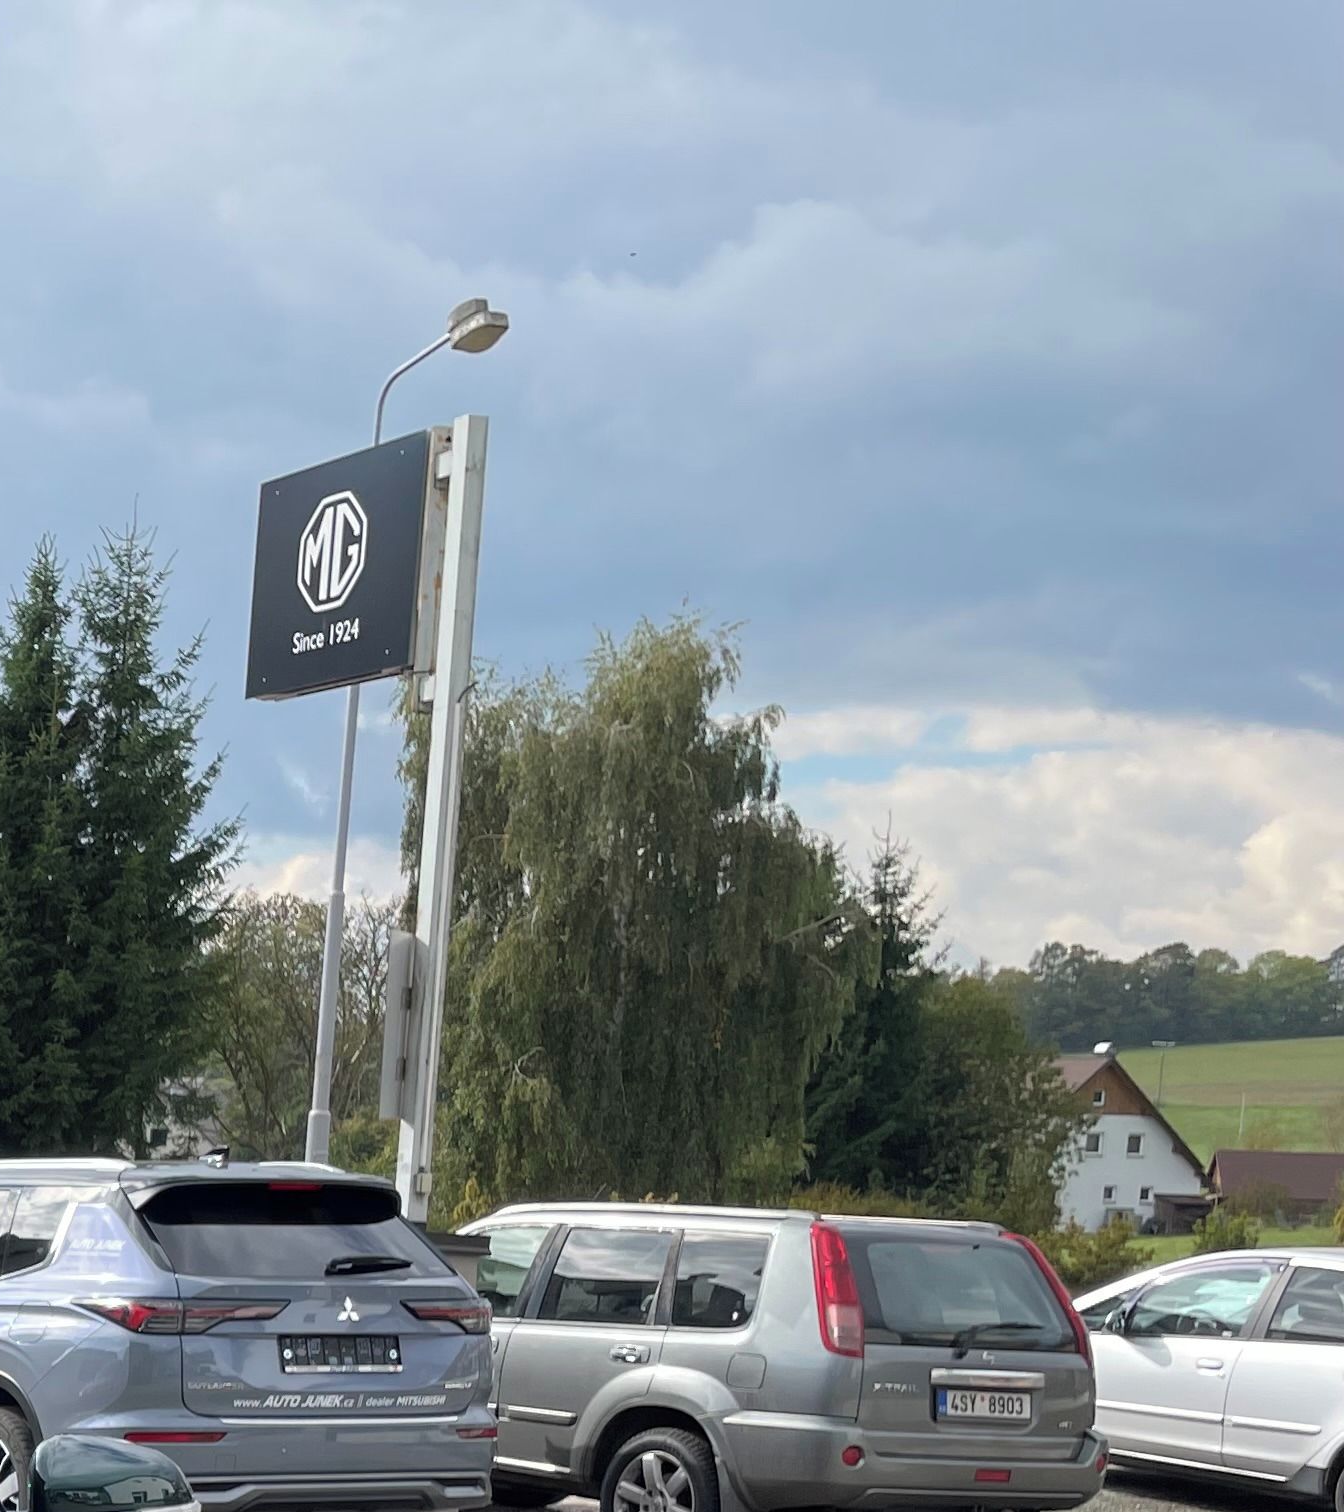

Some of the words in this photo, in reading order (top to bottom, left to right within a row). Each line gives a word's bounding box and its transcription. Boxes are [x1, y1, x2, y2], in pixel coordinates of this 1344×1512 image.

[303, 502, 361, 601] MG
[292, 631, 325, 654] Since
[328, 617, 360, 645] 1924
[951, 1392, 977, 1413] 4SY
[988, 1395, 1024, 1415] 8903
